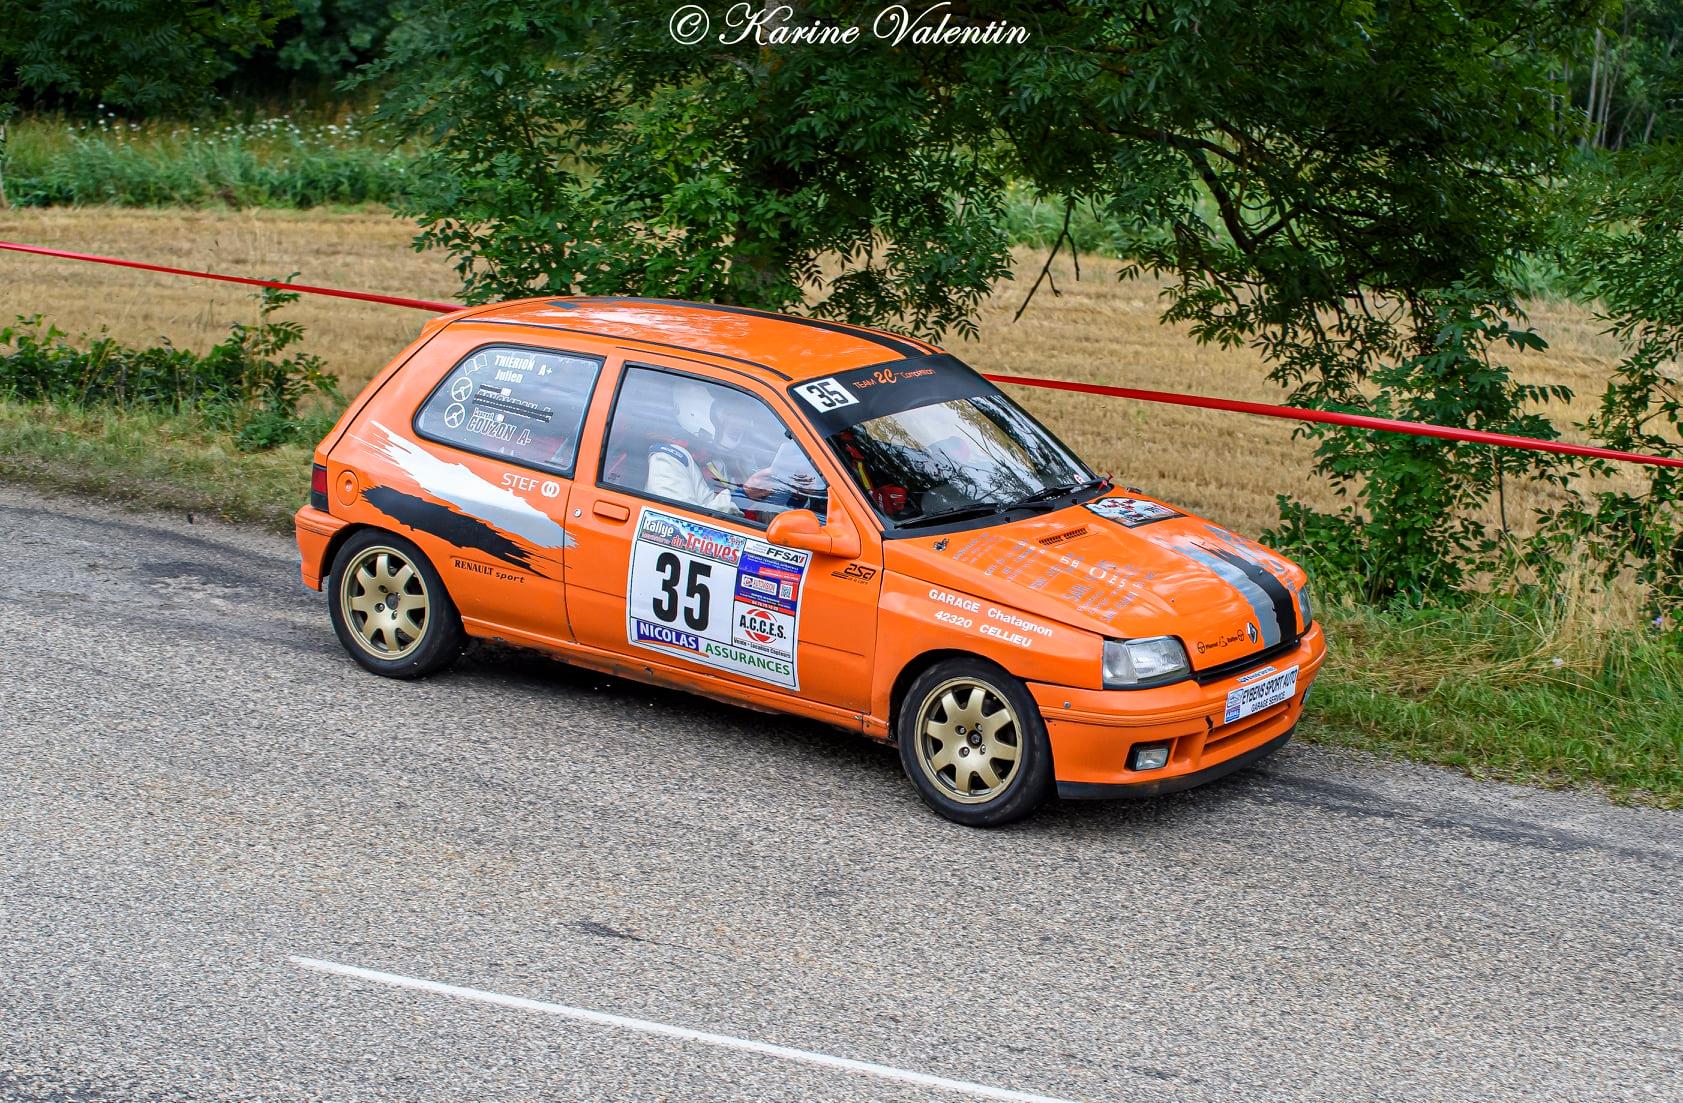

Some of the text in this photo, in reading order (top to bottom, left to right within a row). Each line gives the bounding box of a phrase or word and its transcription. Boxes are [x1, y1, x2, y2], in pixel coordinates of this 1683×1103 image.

[494, 355, 535, 371] THIERION
[495, 369, 523, 384] Julien
[852, 379, 877, 389] TEAM
[806, 382, 849, 407] 35
[501, 473, 539, 492] STEF
[643, 518, 674, 538] Rallye
[766, 547, 803, 563] FFSA
[454, 560, 525, 583] RENAULT sport
[652, 552, 713, 632] 35
[928, 589, 1053, 637] GARAGE Chatagnon
[739, 615, 786, 639] A.C.C.E.S.
[934, 610, 1032, 648] 42320 CELLIEU
[639, 622, 790, 676] NICOLAS ASSURANCES
[1265, 674, 1285, 697] SPORT
[1281, 669, 1298, 689] AUTO
